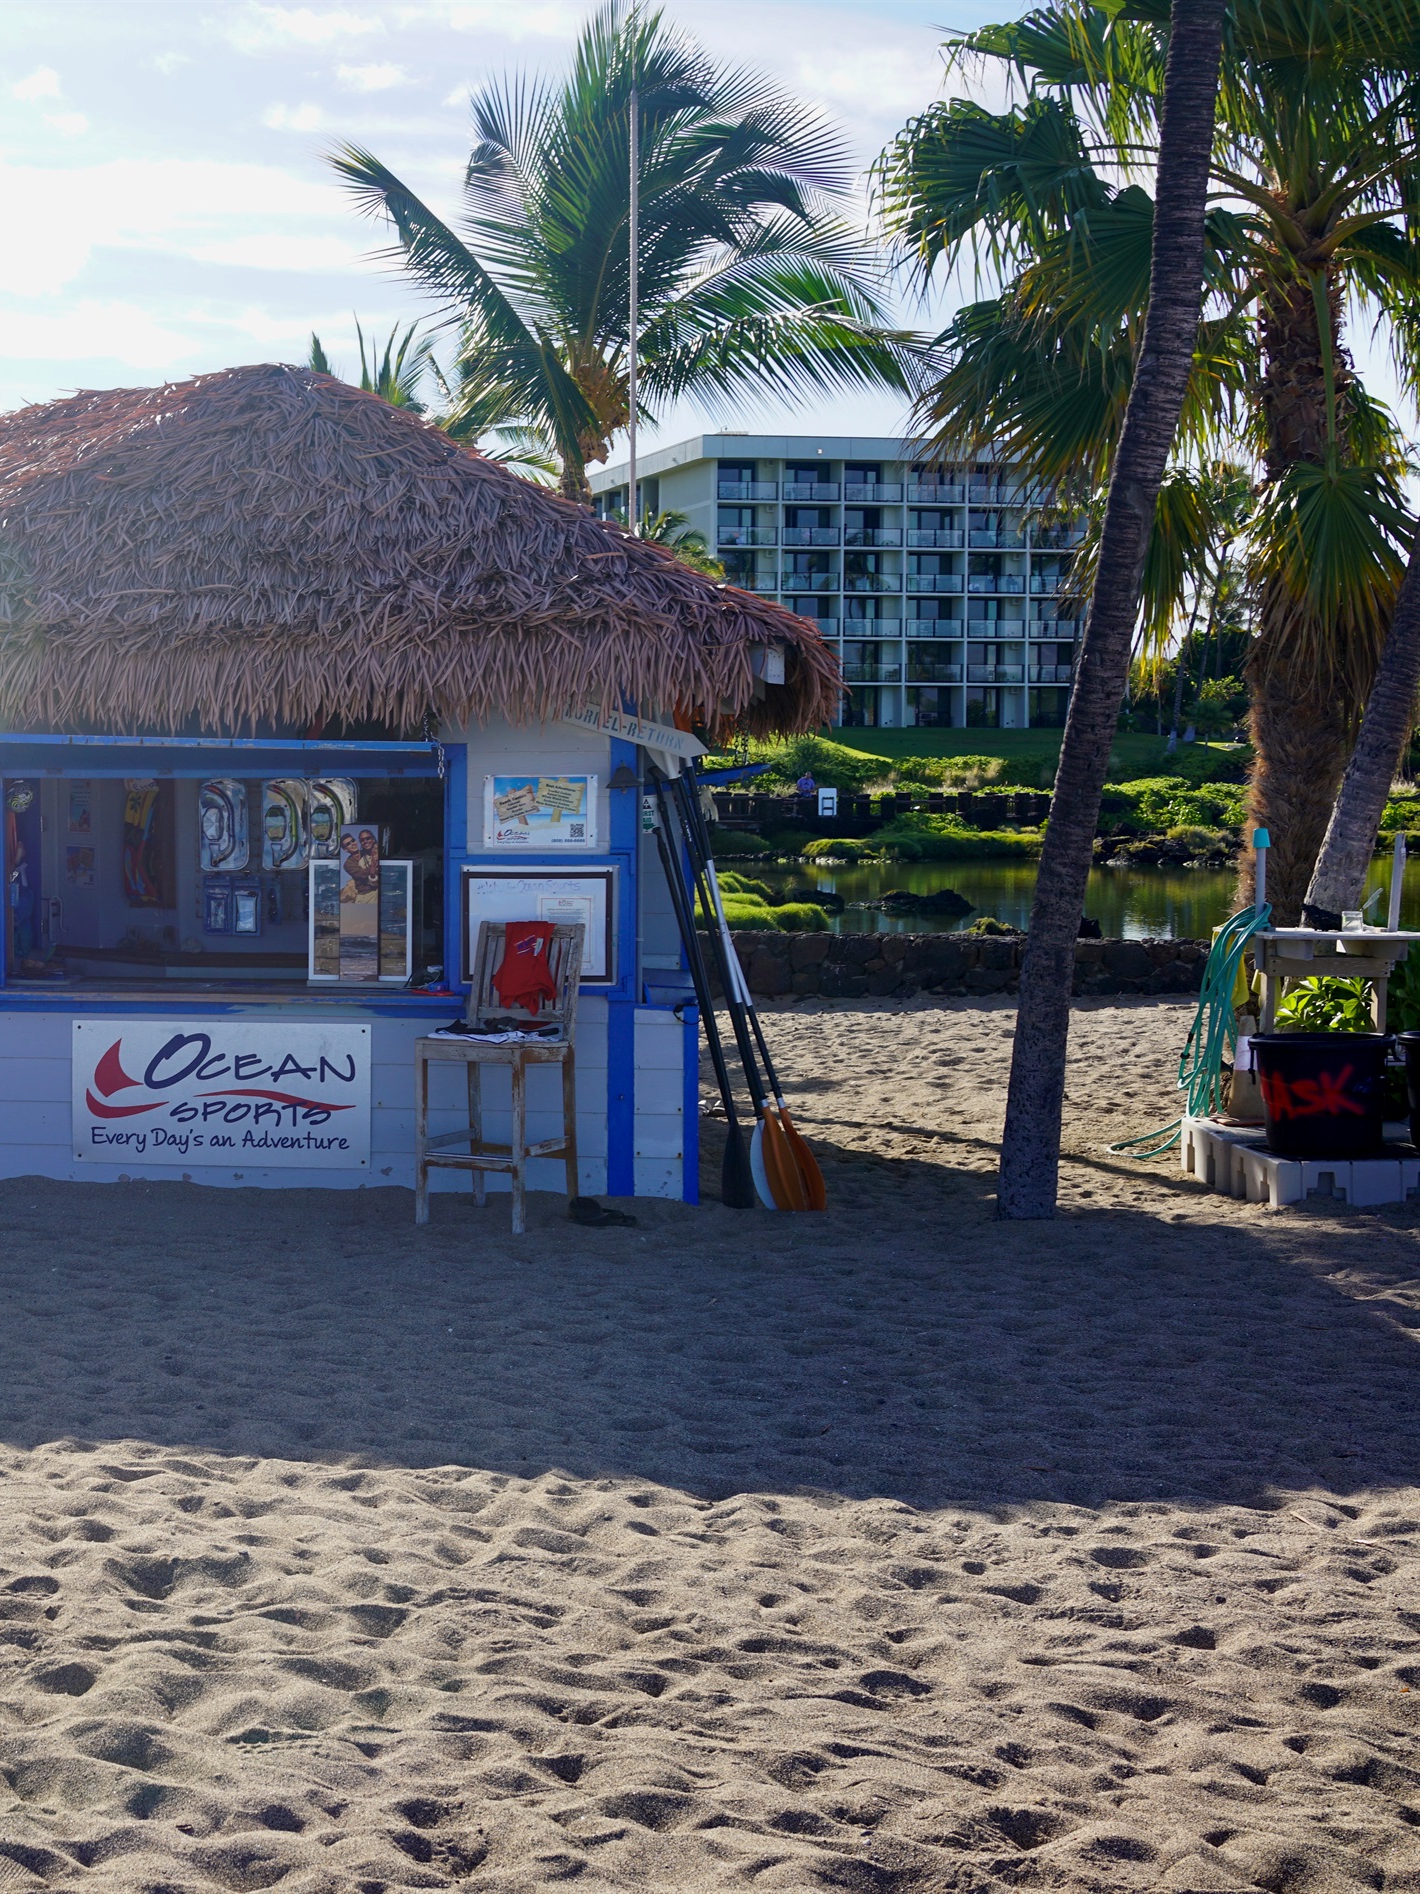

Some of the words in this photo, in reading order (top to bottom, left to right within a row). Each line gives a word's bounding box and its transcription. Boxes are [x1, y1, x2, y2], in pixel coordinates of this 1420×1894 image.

[143, 1033, 356, 1089] OCEAN
[170, 1101, 331, 1127] SPORTS
[91, 1127, 147, 1153] Every
[151, 1127, 204, 1154] Day's
[210, 1134, 235, 1147] an
[242, 1130, 350, 1150] Adventure
